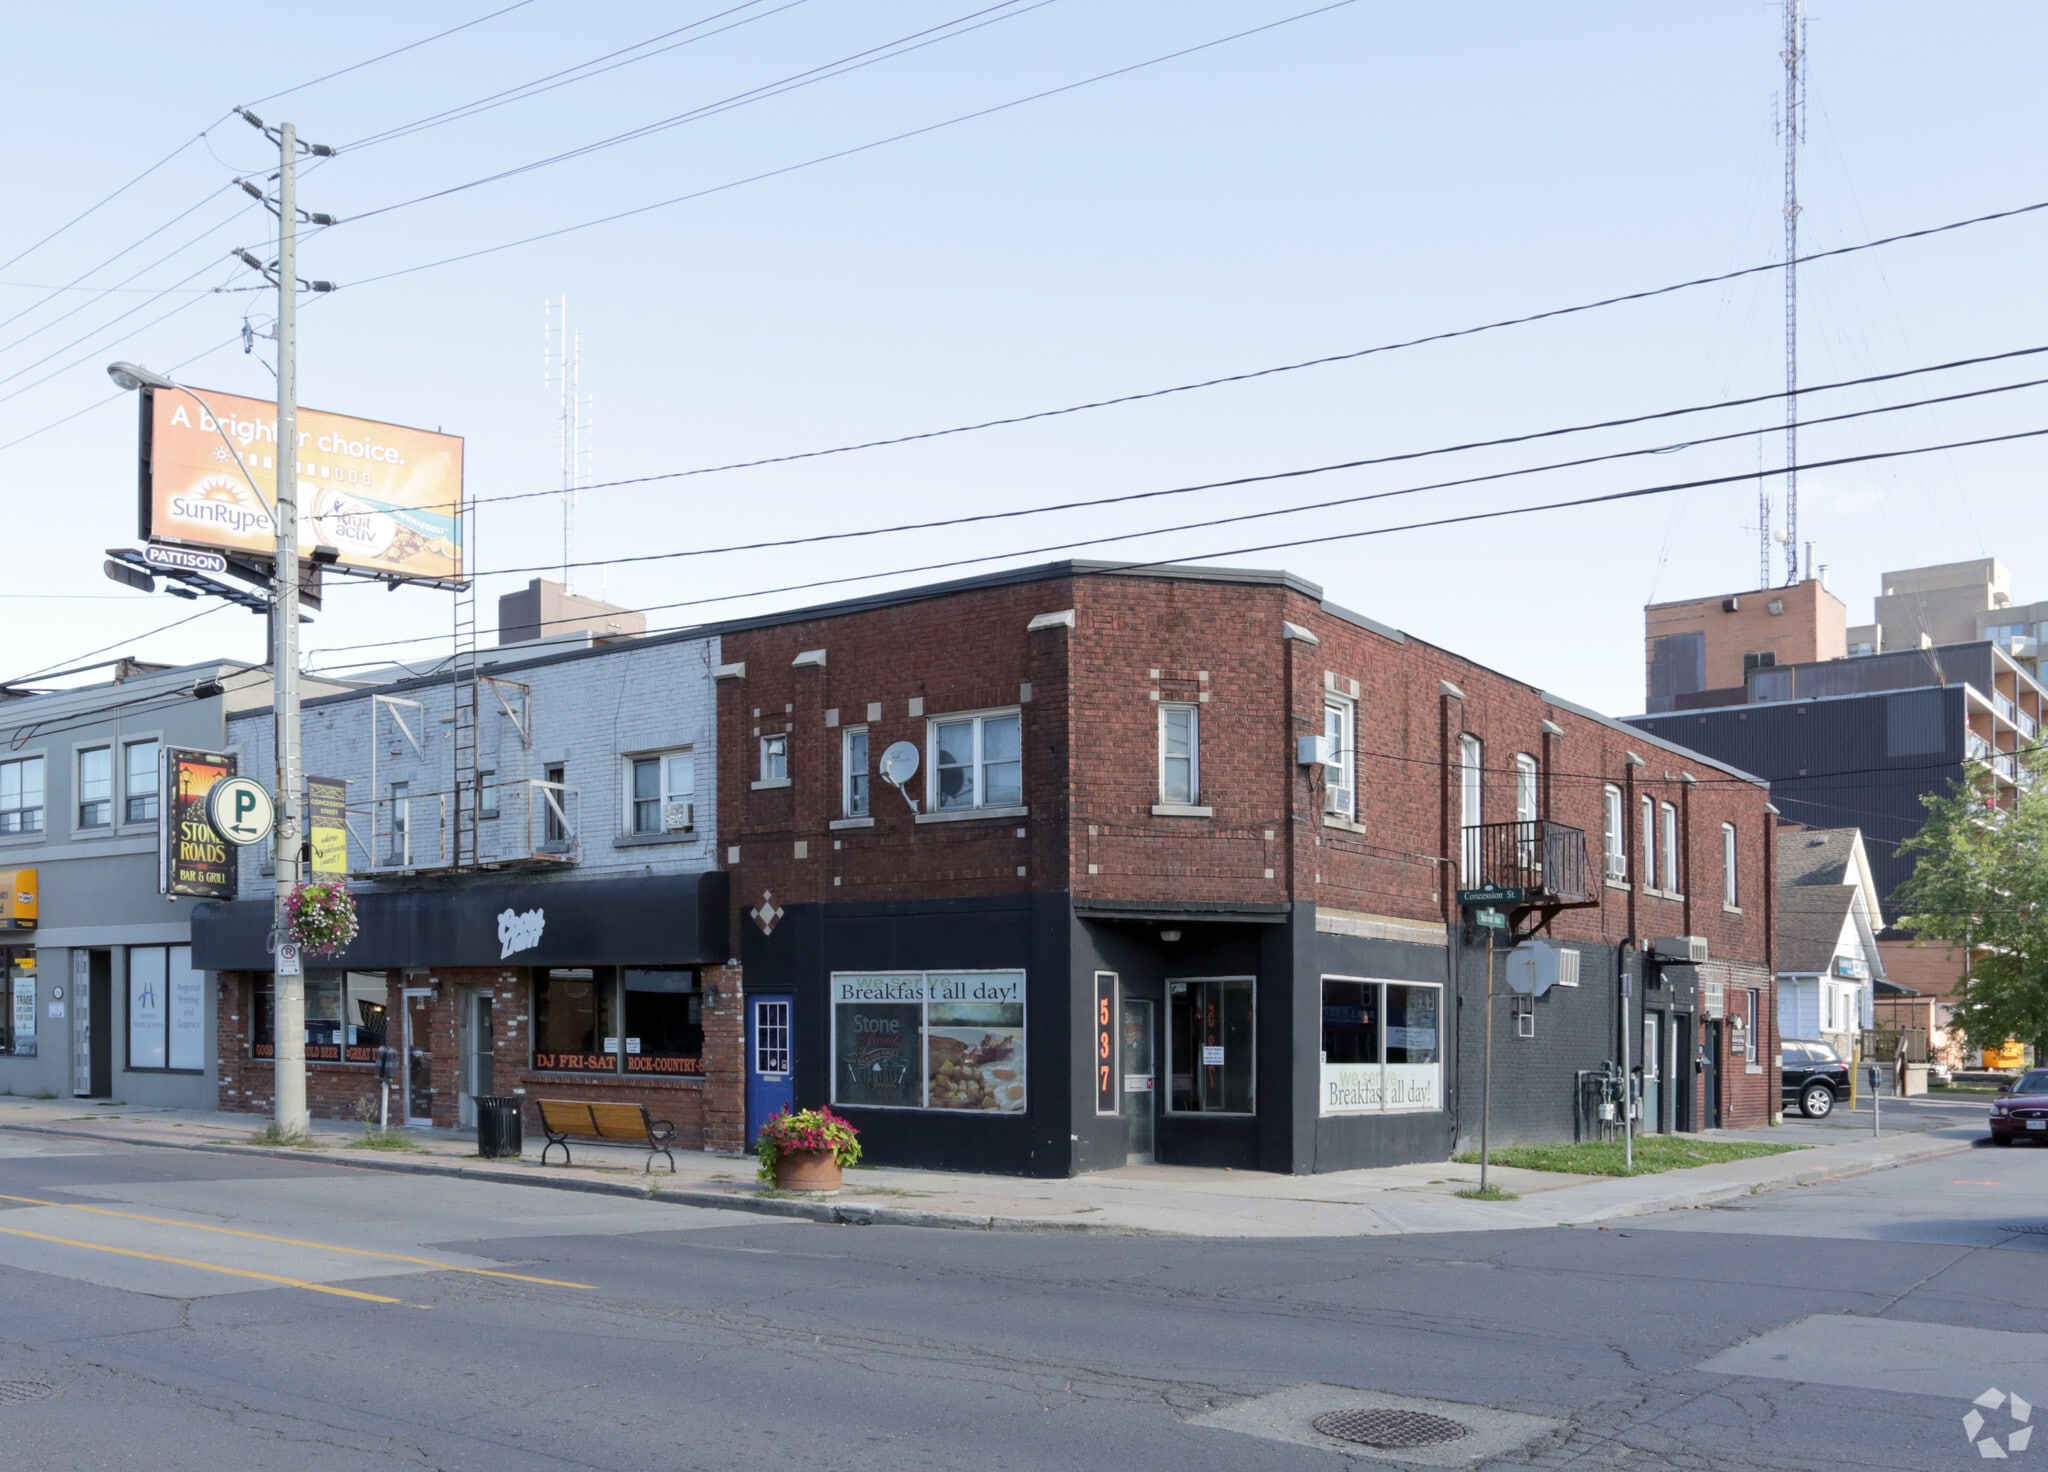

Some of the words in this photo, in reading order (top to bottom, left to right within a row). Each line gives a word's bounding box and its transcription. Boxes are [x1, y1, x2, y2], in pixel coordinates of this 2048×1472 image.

[170, 404, 192, 428] A
[199, 406, 310, 446] brightr
[317, 431, 405, 465] choice.
[173, 498, 268, 532] SunRype
[335, 524, 376, 542] activ
[150, 549, 219, 570] PATTISON
[235, 789, 256, 823] P
[311, 799, 346, 808] CONCESSION
[181, 841, 226, 863] ROADS
[180, 869, 196, 882] BAR
[198, 871, 205, 882] &
[206, 872, 226, 883] GRILL
[1464, 891, 1503, 900] Concession
[856, 977, 884, 988] we
[841, 982, 937, 1000] Breakfast
[943, 982, 966, 1000] all
[973, 982, 1017, 1004] day!
[854, 1013, 900, 1034] Stone
[1124, 1012, 1144, 1024] Stone
[256, 1044, 273, 1056] GOOD
[321, 1046, 338, 1058] BEER
[536, 1054, 556, 1067] DJ
[559, 1054, 616, 1070] FRI-SAT
[1340, 1071, 1358, 1087] we
[1329, 1080, 1388, 1106] Breakfast
[1391, 1079, 1404, 1104] all
[1408, 1079, 1431, 1109] day!
